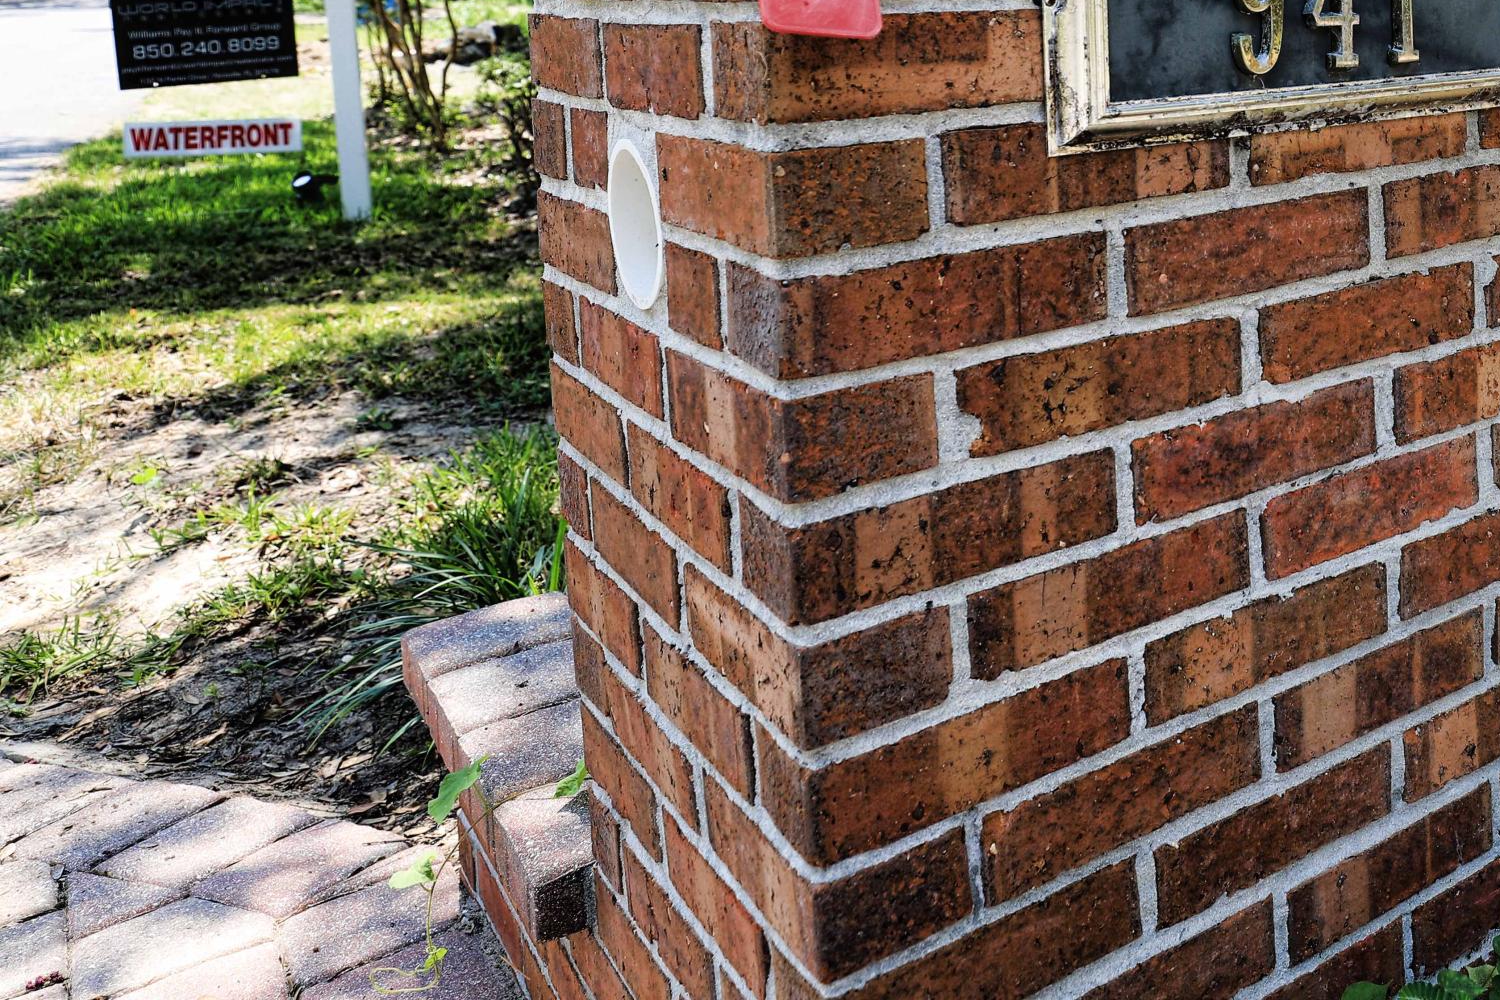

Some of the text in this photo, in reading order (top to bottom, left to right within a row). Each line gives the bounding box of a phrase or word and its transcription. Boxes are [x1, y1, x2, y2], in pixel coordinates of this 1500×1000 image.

[117, 1, 197, 15] WORLD
[127, 29, 171, 40] Williams
[132, 35, 280, 60] 850.240.8099
[130, 122, 293, 152] WATERFRONT
